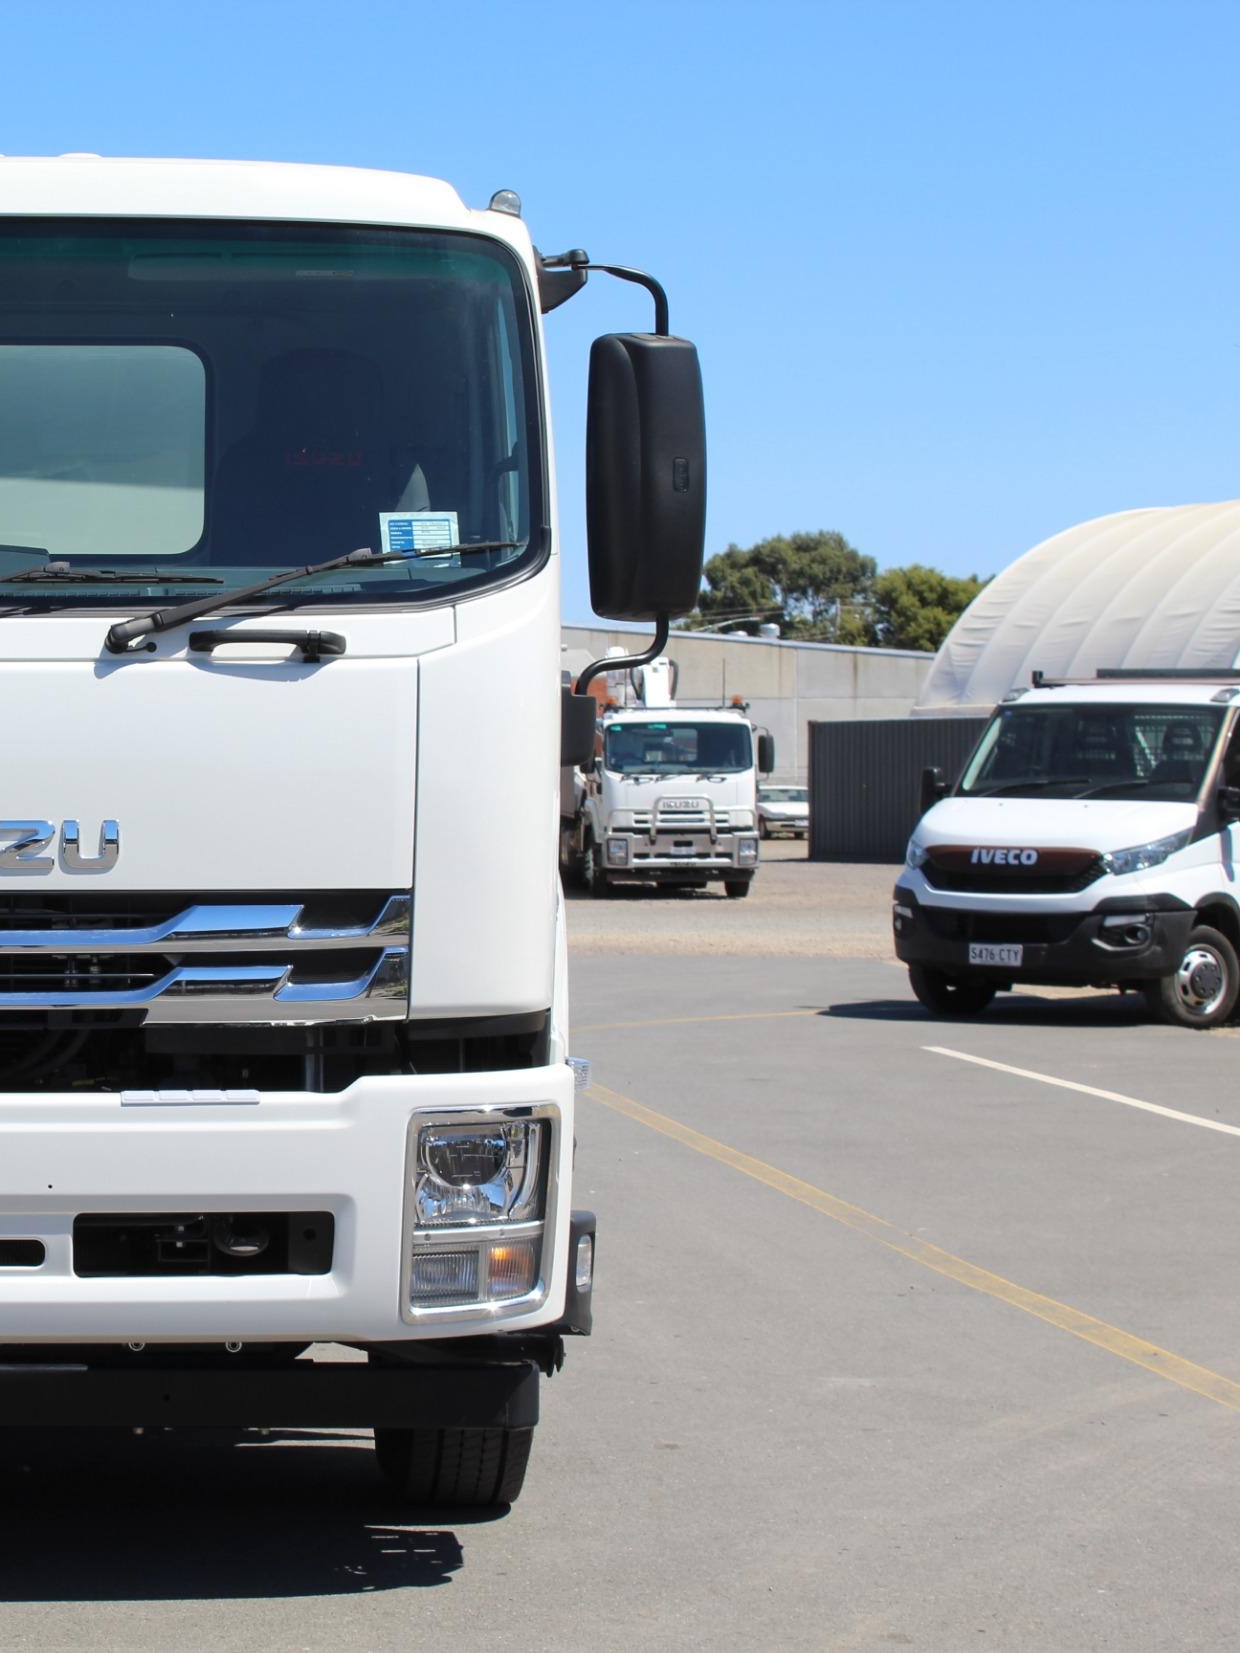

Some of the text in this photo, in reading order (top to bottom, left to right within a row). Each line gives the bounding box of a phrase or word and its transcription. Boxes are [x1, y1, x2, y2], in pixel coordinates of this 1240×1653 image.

[970, 847, 1038, 866] IVECO
[971, 947, 1020, 961] S476 CTY
